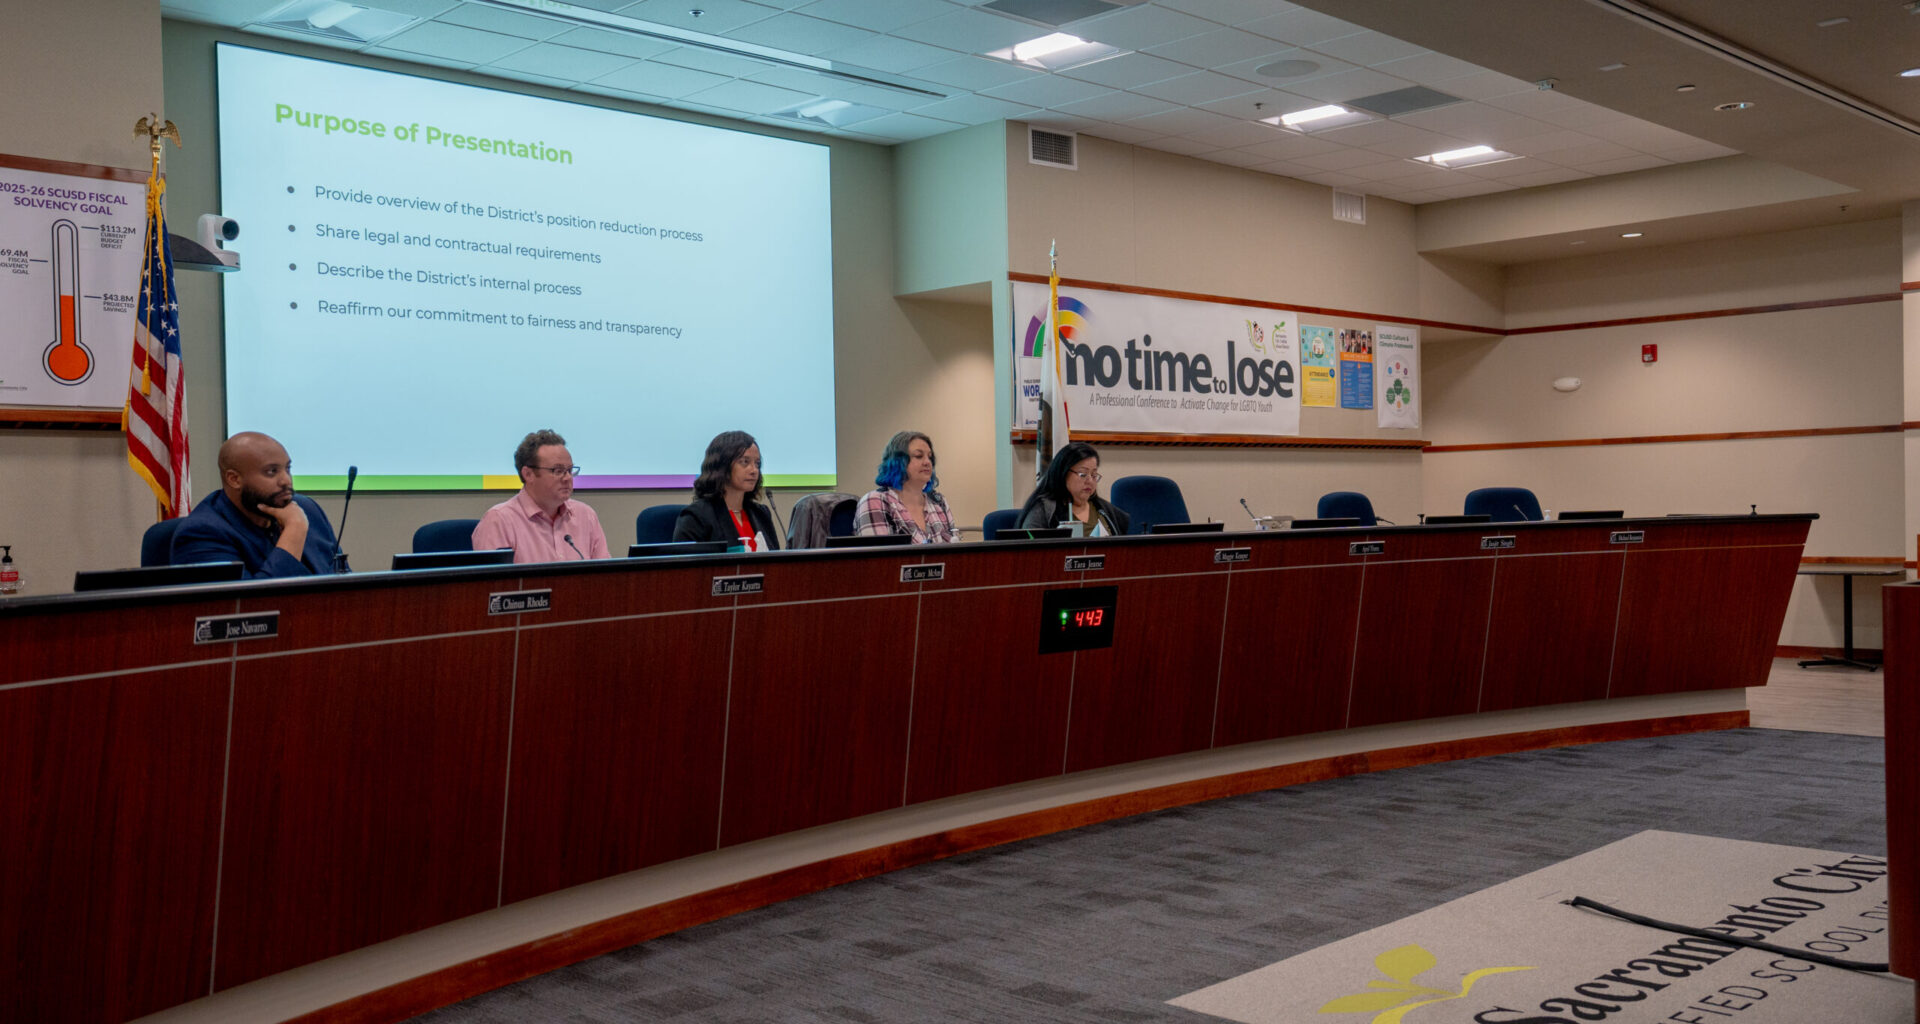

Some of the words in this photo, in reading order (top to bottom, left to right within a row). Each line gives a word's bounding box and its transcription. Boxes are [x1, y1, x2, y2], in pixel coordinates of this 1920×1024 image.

[275, 103, 386, 138] Purpose
[394, 122, 419, 142] of
[426, 125, 573, 165] Presentation
[0, 182, 45, 196] 2025-26
[47, 187, 86, 200] SCUSD
[89, 192, 128, 205] FISCAL
[14, 196, 78, 211] SOLVENCY
[80, 203, 113, 216] GOAL
[315, 185, 373, 205] Provide
[376, 195, 441, 212] overview
[444, 200, 458, 214] of
[461, 203, 484, 217] the
[488, 205, 544, 224] District's
[547, 214, 596, 230] position
[599, 220, 657, 237] reduction
[660, 228, 703, 242] process
[100, 224, 136, 235] $113.2M
[316, 223, 360, 241] Share
[364, 227, 399, 246] legal
[404, 233, 431, 248] and
[435, 237, 511, 255] contractual
[516, 246, 601, 264] requirements
[317, 262, 384, 280] Describe
[388, 268, 412, 282] the
[417, 269, 476, 287] District's
[480, 275, 530, 292] internal
[534, 282, 582, 296] process
[103, 293, 134, 302] $43.8M
[318, 300, 383, 317] Reaffirm
[387, 307, 412, 319] our
[416, 308, 508, 325] commitment
[511, 313, 524, 326] to
[528, 314, 576, 330] fairness
[579, 319, 602, 331] and
[606, 320, 683, 340] transparency
[1124, 334, 1212, 393] time
[1213, 377, 1227, 394] to
[1227, 340, 1294, 398] lose
[1090, 395, 1095, 405] A
[1095, 394, 1136, 407] Professional
[1137, 397, 1170, 409] Conference
[1171, 400, 1177, 409] to
[1180, 399, 1206, 410] Activate
[1207, 400, 1230, 413] Change
[1230, 400, 1239, 412] for
[1239, 401, 1257, 412] LGBTQ
[1258, 401, 1273, 413] Youth
[724, 581, 740, 593] Taylor
[527, 596, 548, 608] Rhodes
[225, 622, 240, 639] Jose
[241, 620, 268, 635] Navarro
[1658, 985, 1769, 1024] FIED
[1751, 925, 1885, 983] SCOOL
